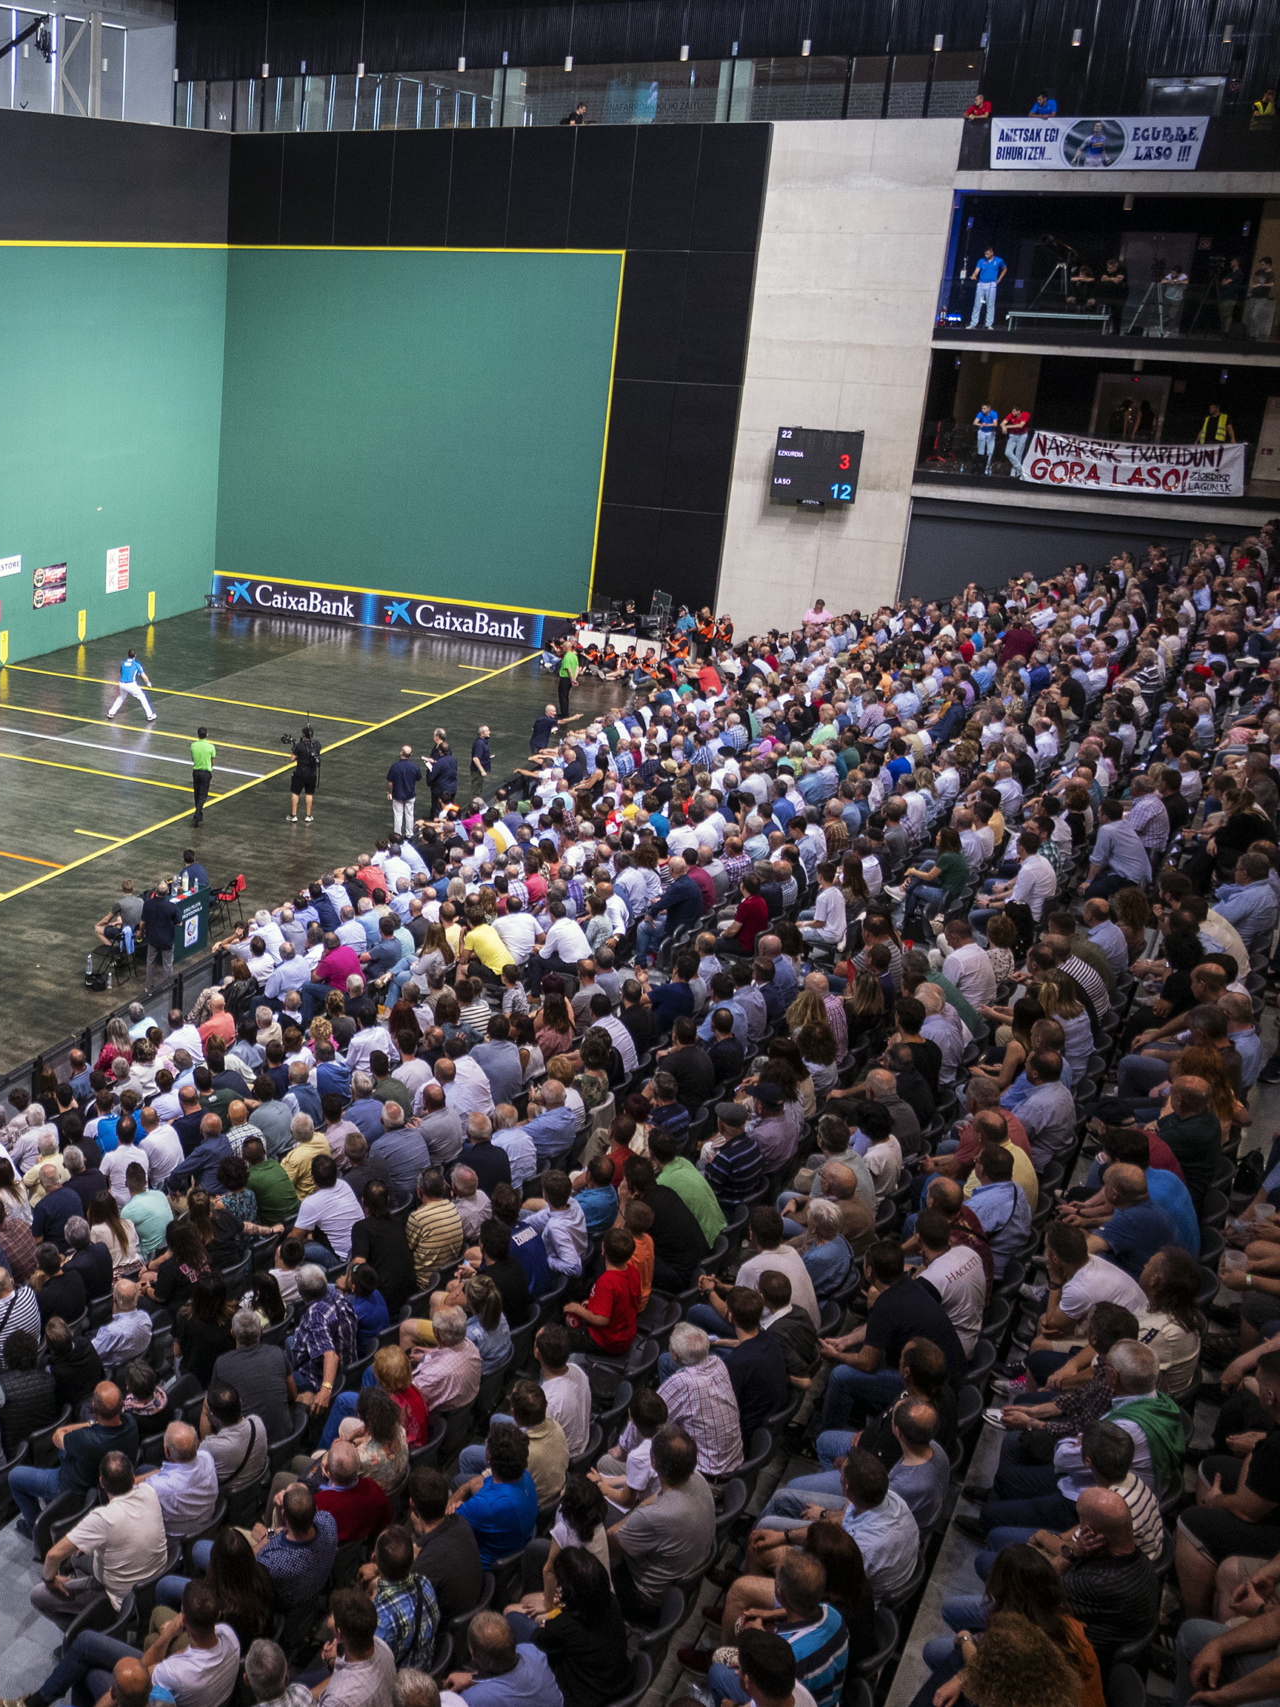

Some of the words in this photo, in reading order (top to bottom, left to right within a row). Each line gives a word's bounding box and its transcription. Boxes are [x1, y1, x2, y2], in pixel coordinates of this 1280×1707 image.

[998, 128, 1042, 143] AMETSAK
[1044, 128, 1059, 143] EGI
[996, 146, 1052, 161] BIHURTZEN...
[1133, 146, 1173, 161] LASO
[781, 430, 793, 439] 22
[839, 454, 850, 470] 3
[1030, 458, 1101, 485] GORA
[1110, 465, 1188, 493] LASO!
[830, 483, 852, 500] 12
[255, 584, 355, 618] CaixaBank
[415, 604, 525, 640] CaixaBank
[1, 633, 6, 643] 3
[945, 1256, 980, 1284] HACKETT
